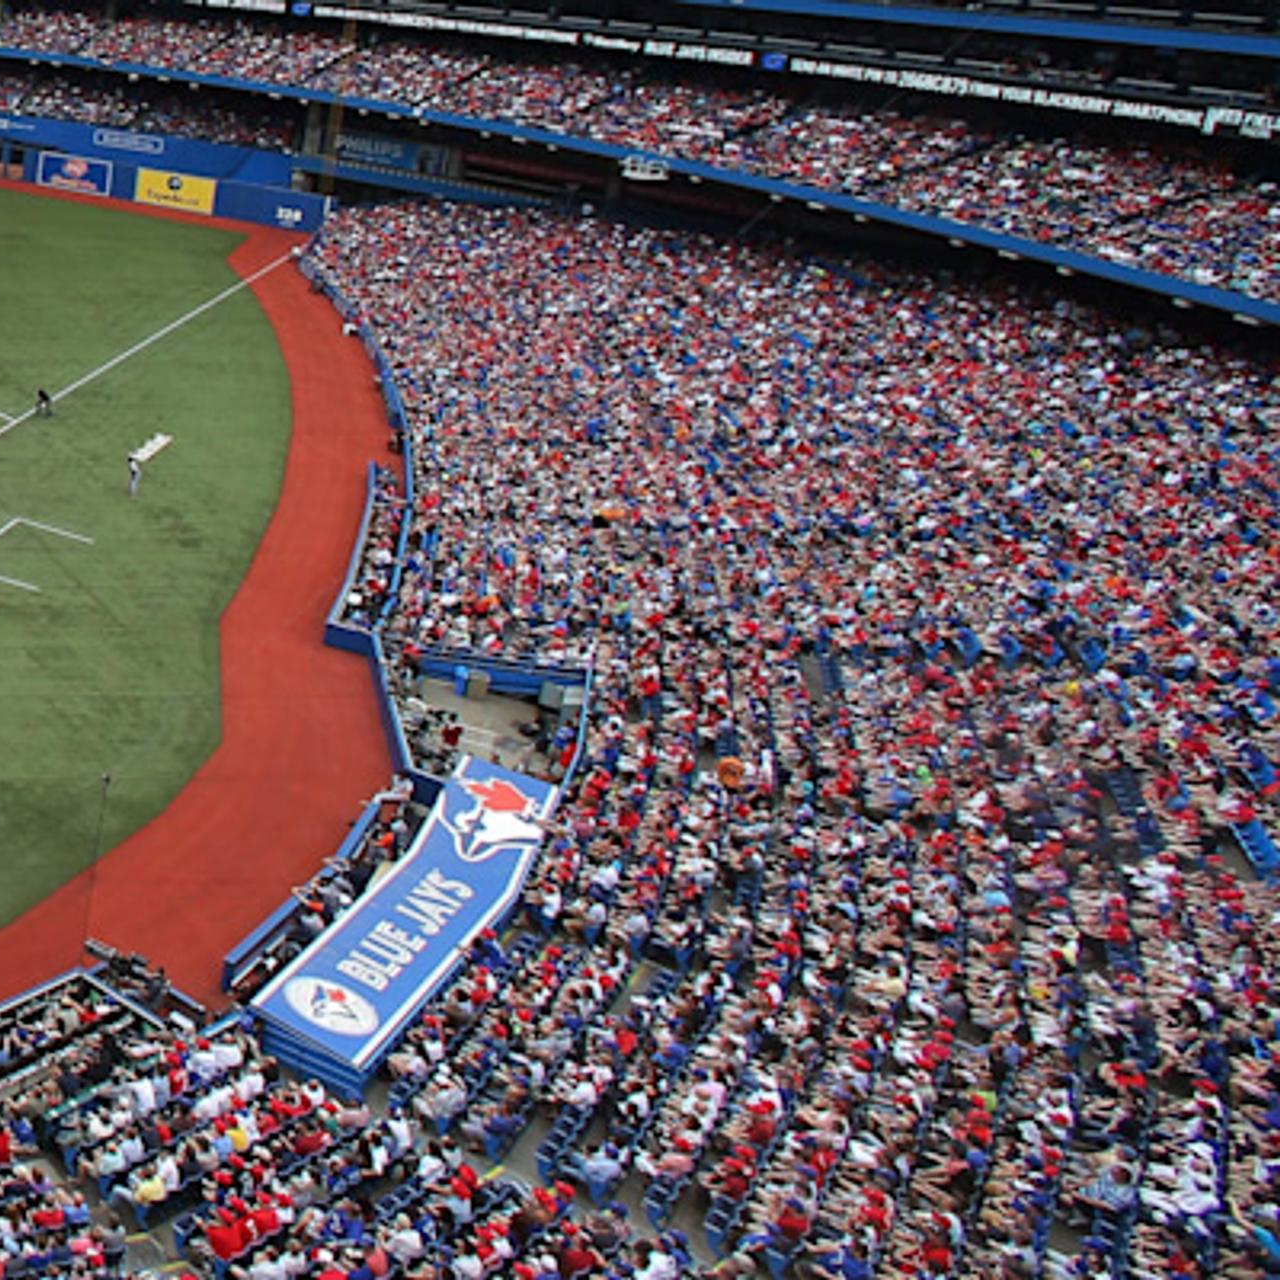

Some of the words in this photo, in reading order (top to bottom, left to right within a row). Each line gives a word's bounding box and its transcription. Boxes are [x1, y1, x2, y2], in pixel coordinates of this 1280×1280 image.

[1033, 88, 1111, 114] BLACKBERRY
[1111, 97, 1204, 127] SMARTPHONE
[336, 919, 428, 993] BLUE
[394, 867, 475, 936] JAYS
